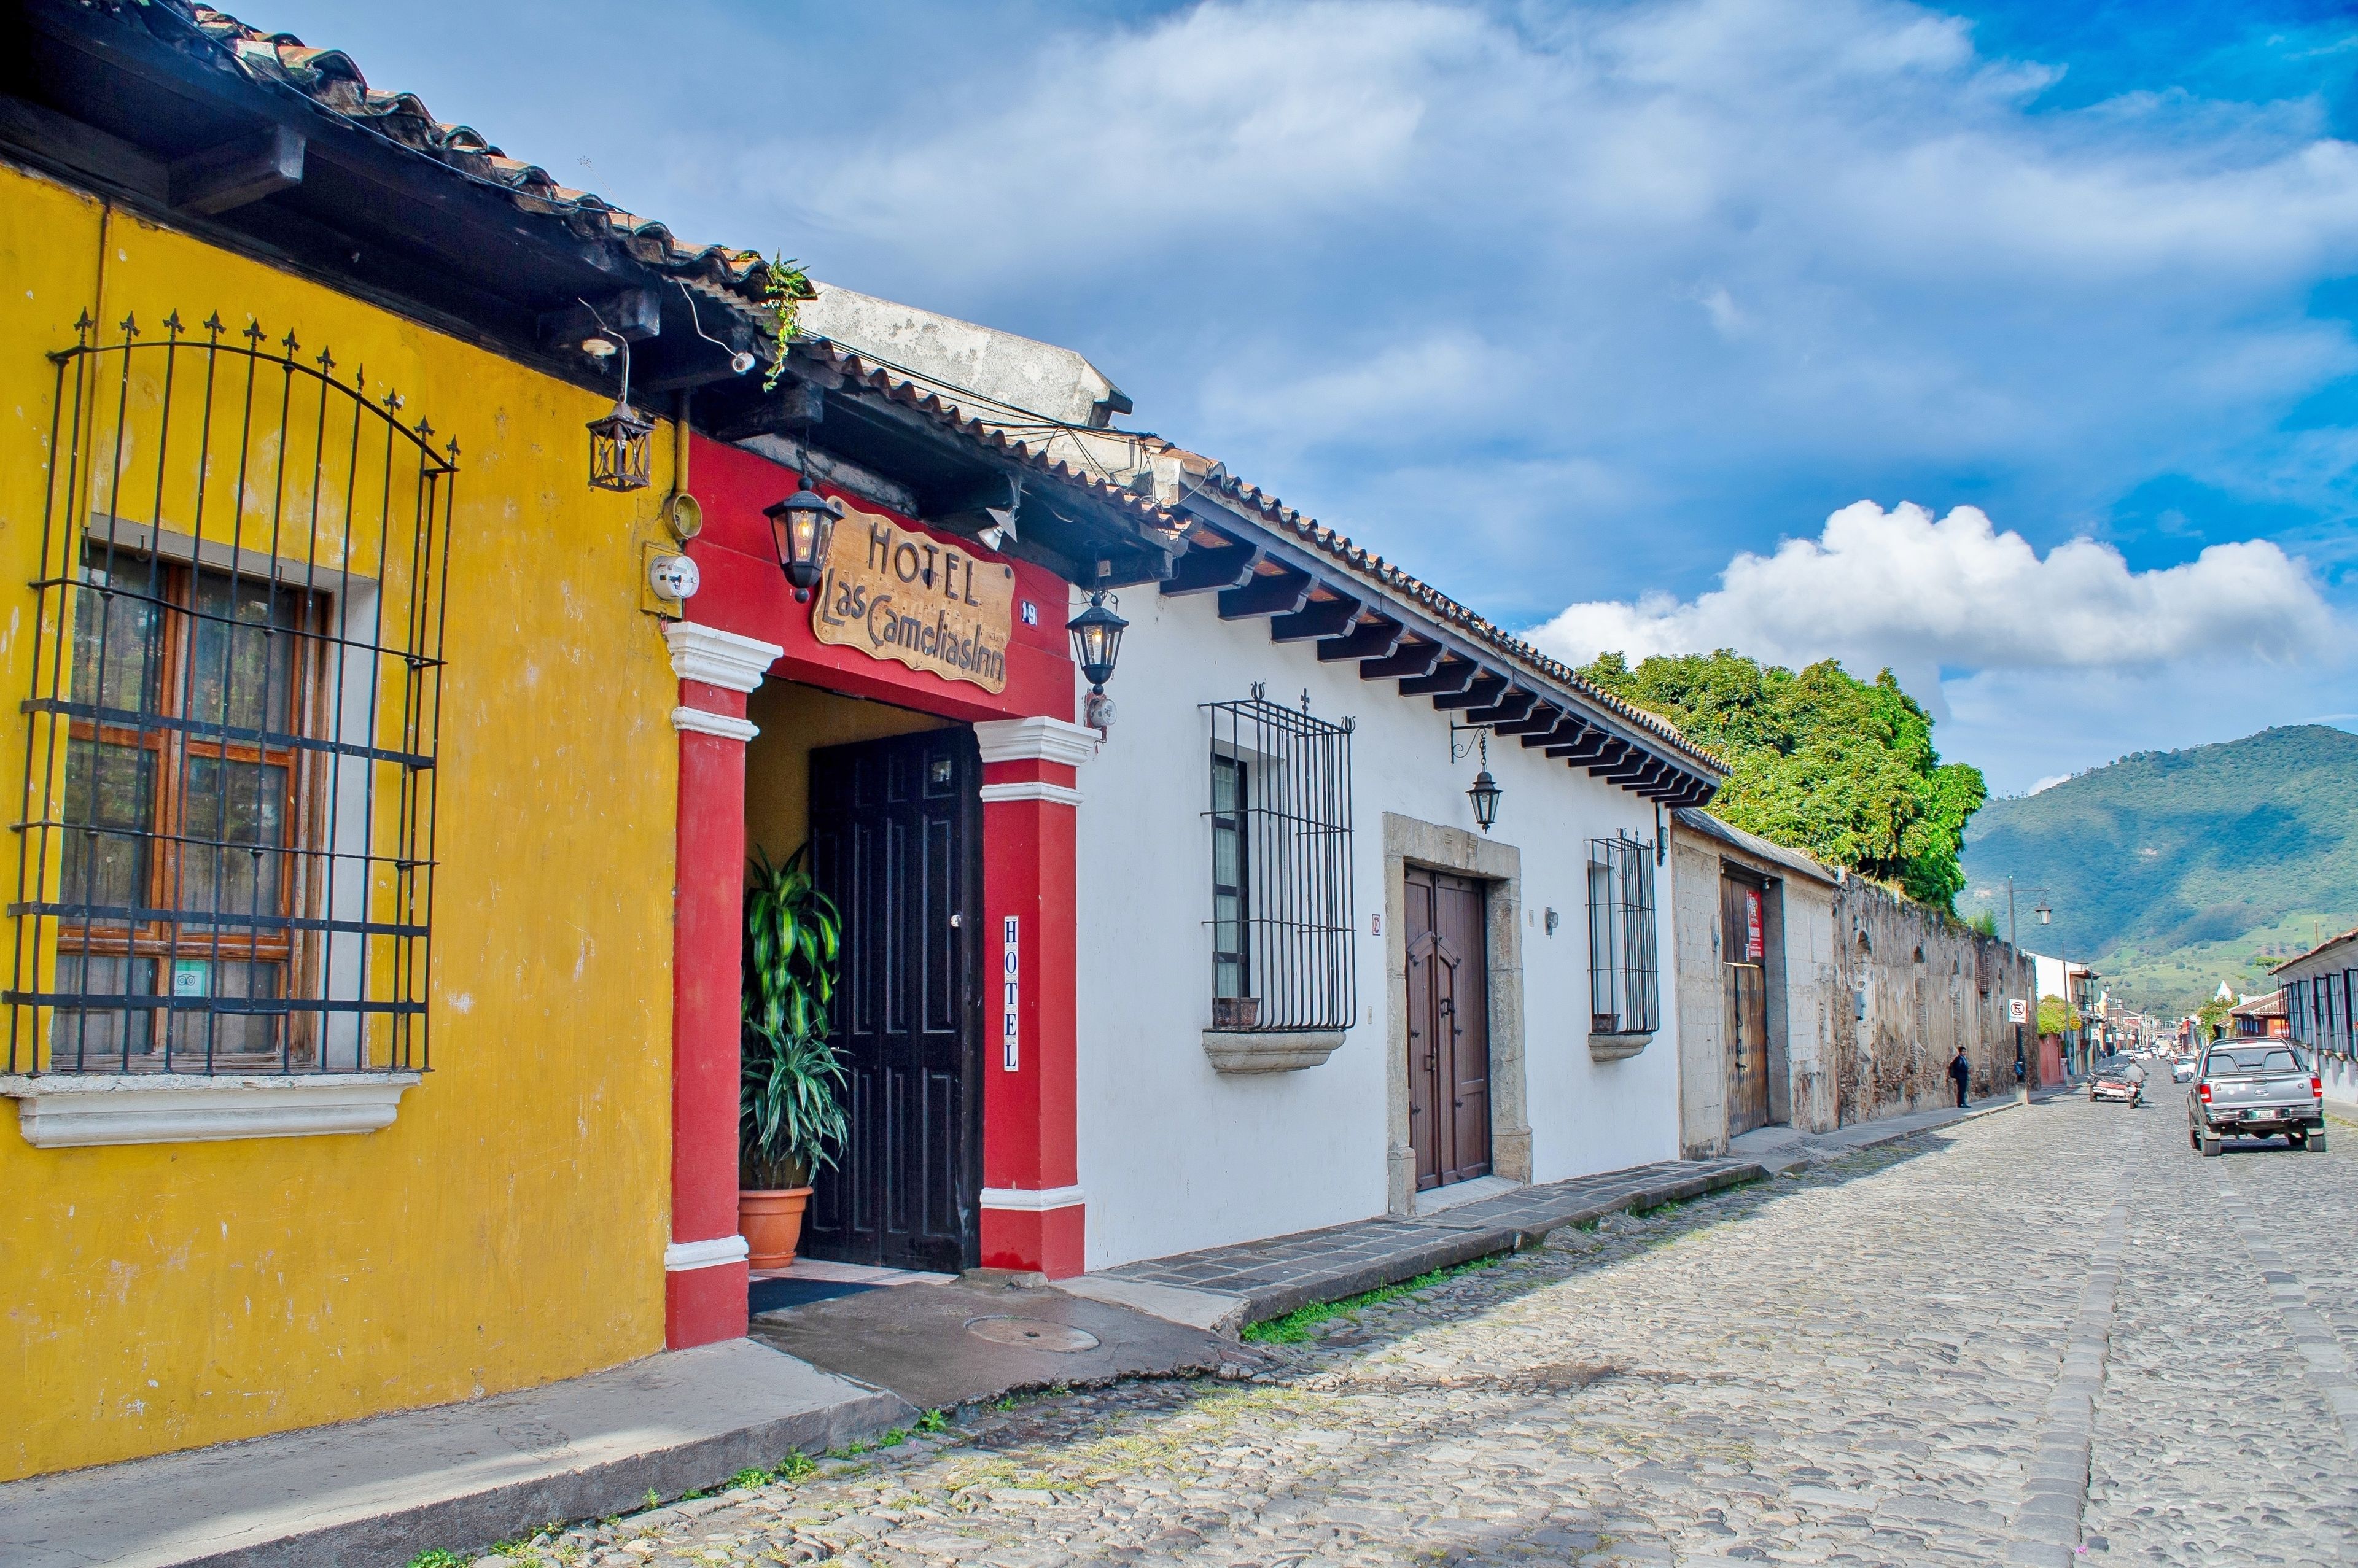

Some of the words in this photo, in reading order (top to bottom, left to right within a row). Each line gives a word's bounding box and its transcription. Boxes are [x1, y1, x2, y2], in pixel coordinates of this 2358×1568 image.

[868, 522, 979, 608] HOTEL
[1022, 601, 1036, 625] 19
[822, 567, 866, 627] Las
[867, 594, 972, 669] Camelias
[971, 624, 1005, 681] Inn
[1005, 920, 1018, 1067] HOTEL
